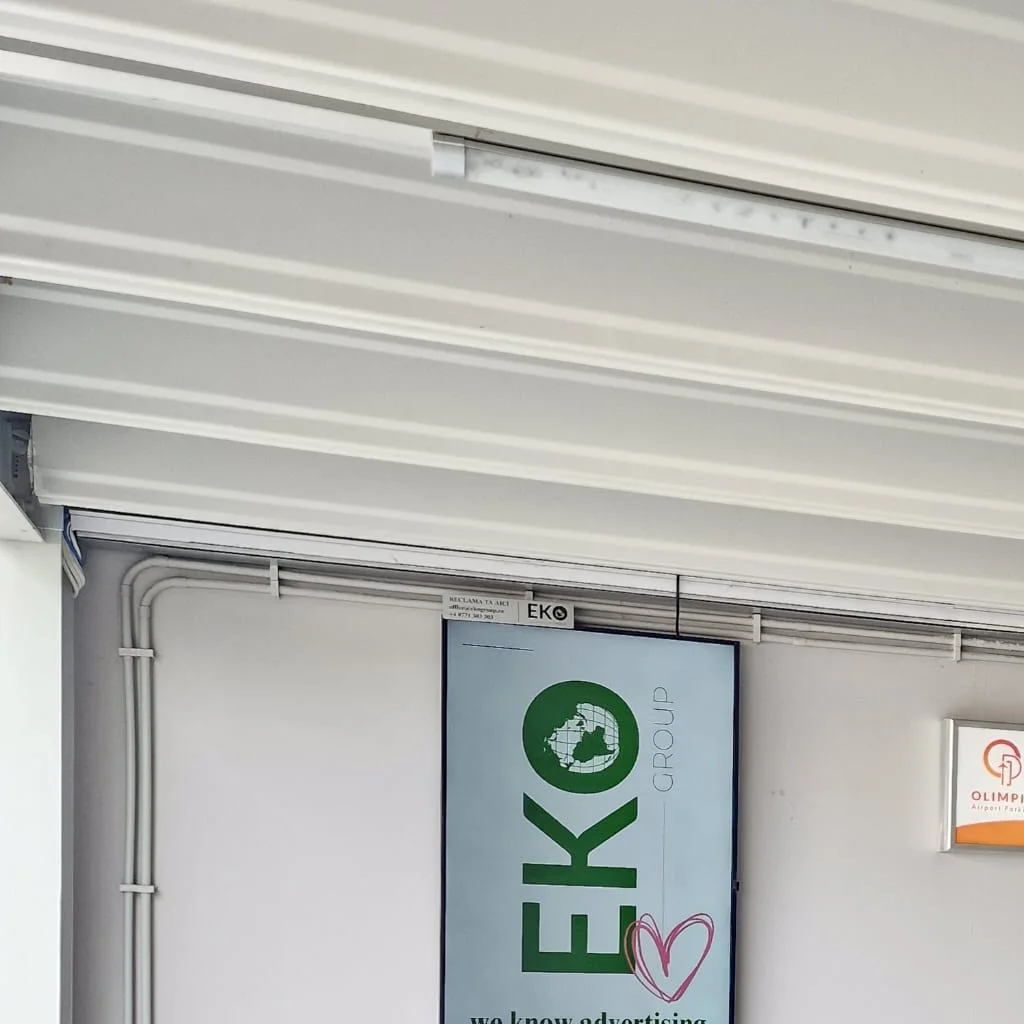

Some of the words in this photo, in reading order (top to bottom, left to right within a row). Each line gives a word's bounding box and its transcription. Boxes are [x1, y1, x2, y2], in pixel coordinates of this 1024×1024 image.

[527, 603, 568, 621] EKO
[652, 686, 675, 793] GROUP
[521, 680, 640, 974] EKO
[971, 803, 1001, 812] Airport
